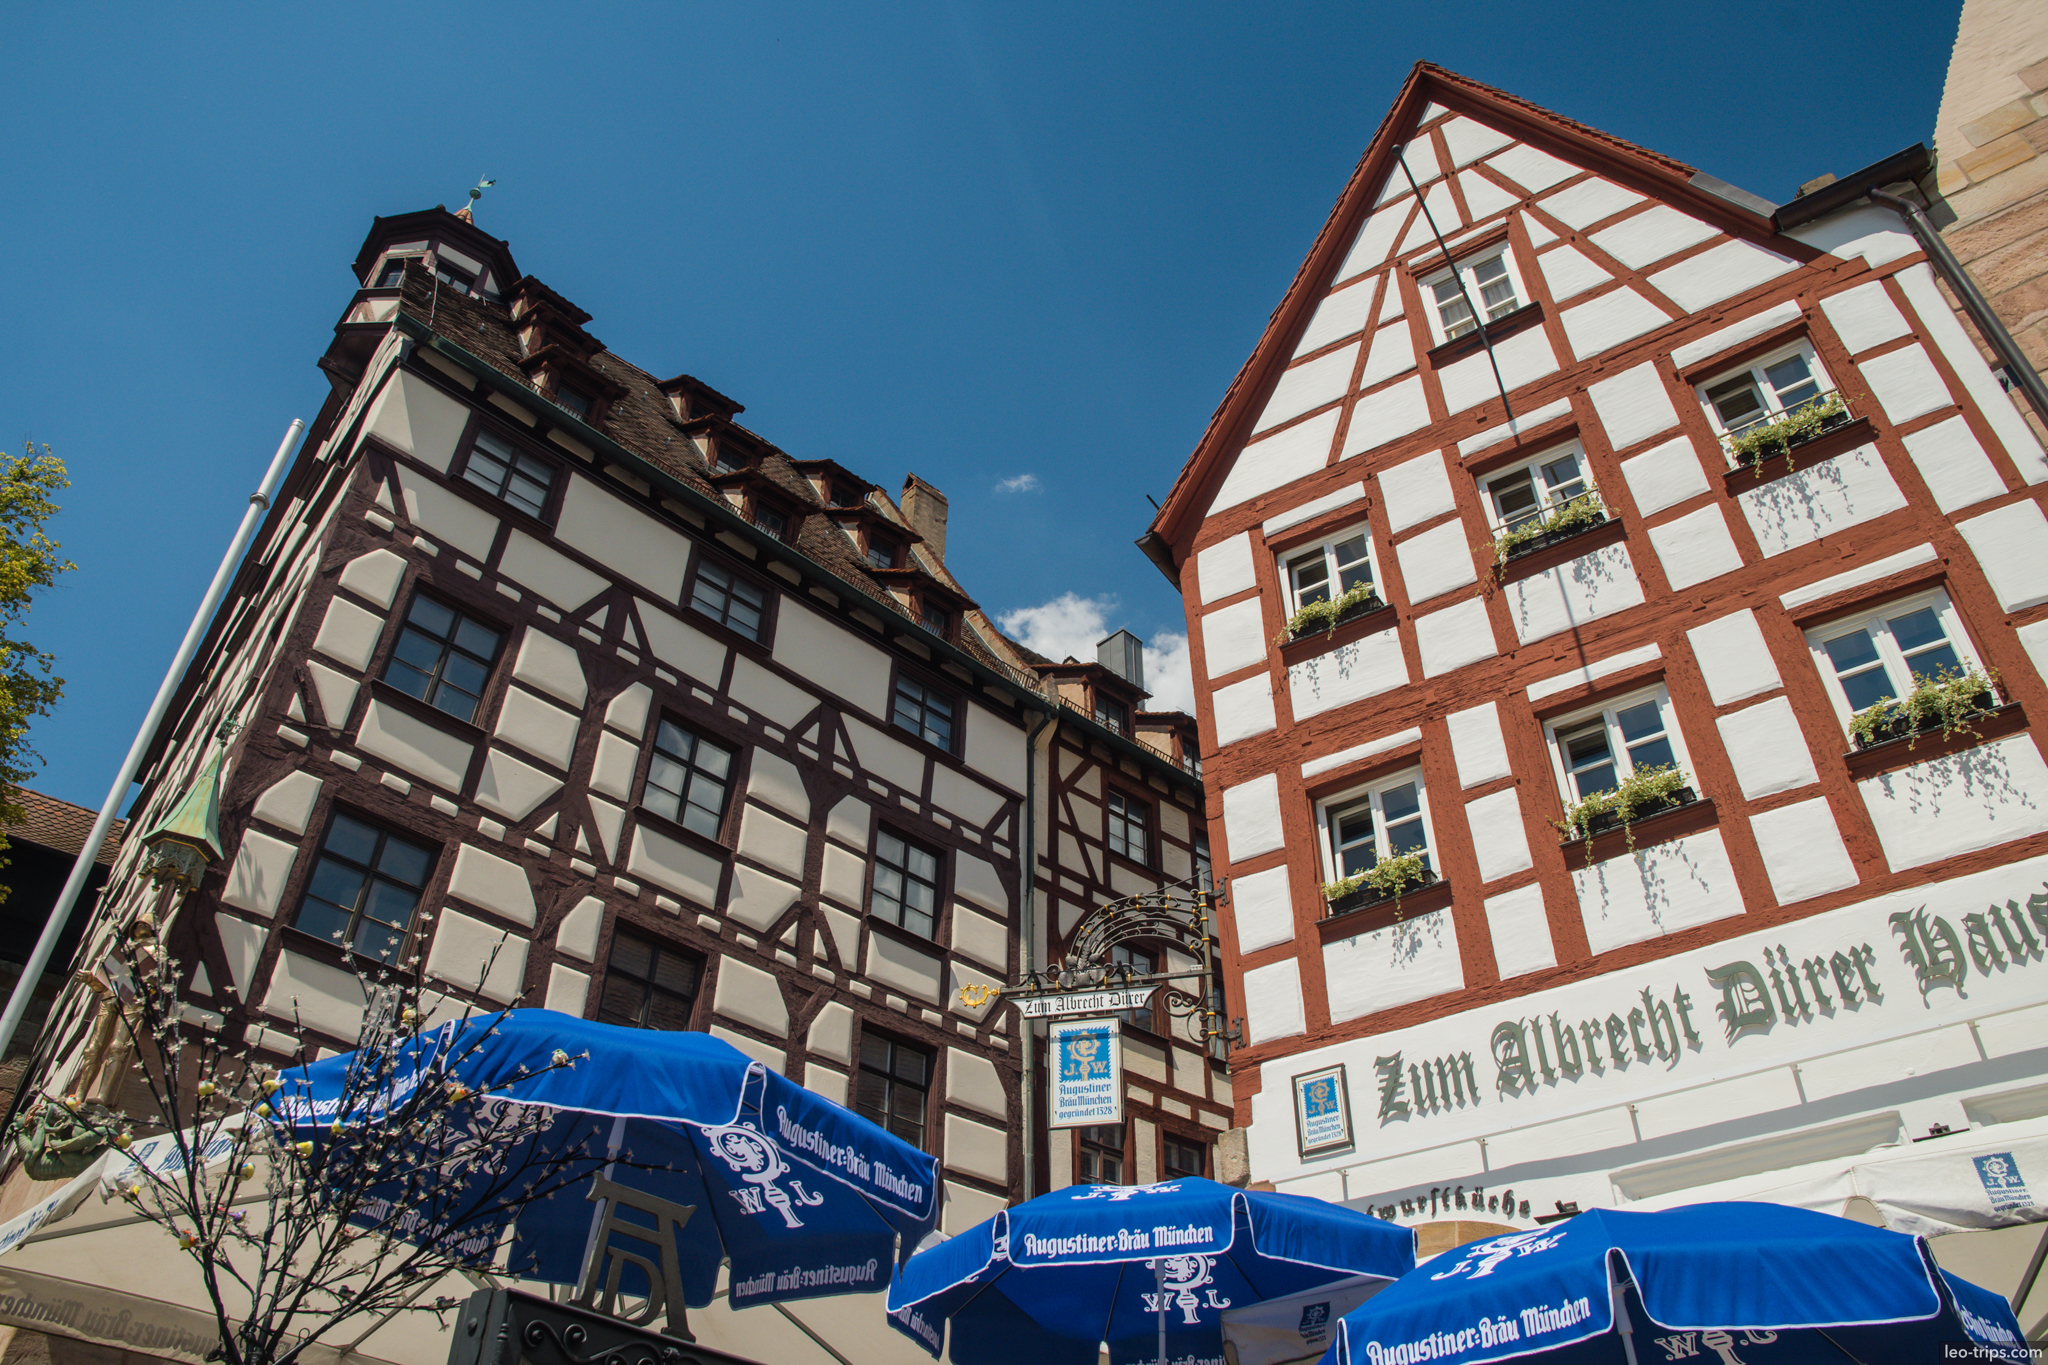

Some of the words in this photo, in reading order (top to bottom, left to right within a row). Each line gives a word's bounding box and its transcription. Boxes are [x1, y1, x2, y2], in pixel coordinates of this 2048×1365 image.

[1025, 1000, 1052, 1016] Zum
[1055, 996, 1105, 1012] Albrecht
[1108, 991, 1145, 1008] Dürer
[1373, 1050, 1479, 1120] Zum
[1491, 982, 1700, 1091] Albrecht
[1703, 943, 1881, 1039] Dürer
[1059, 1096, 1077, 1108] Bräu
[1077, 1094, 1112, 1106] München
[1059, 1108, 1095, 1120] gegründet
[874, 1160, 923, 1204] München
[1152, 1223, 1214, 1247] München
[1520, 1297, 1591, 1337] München
